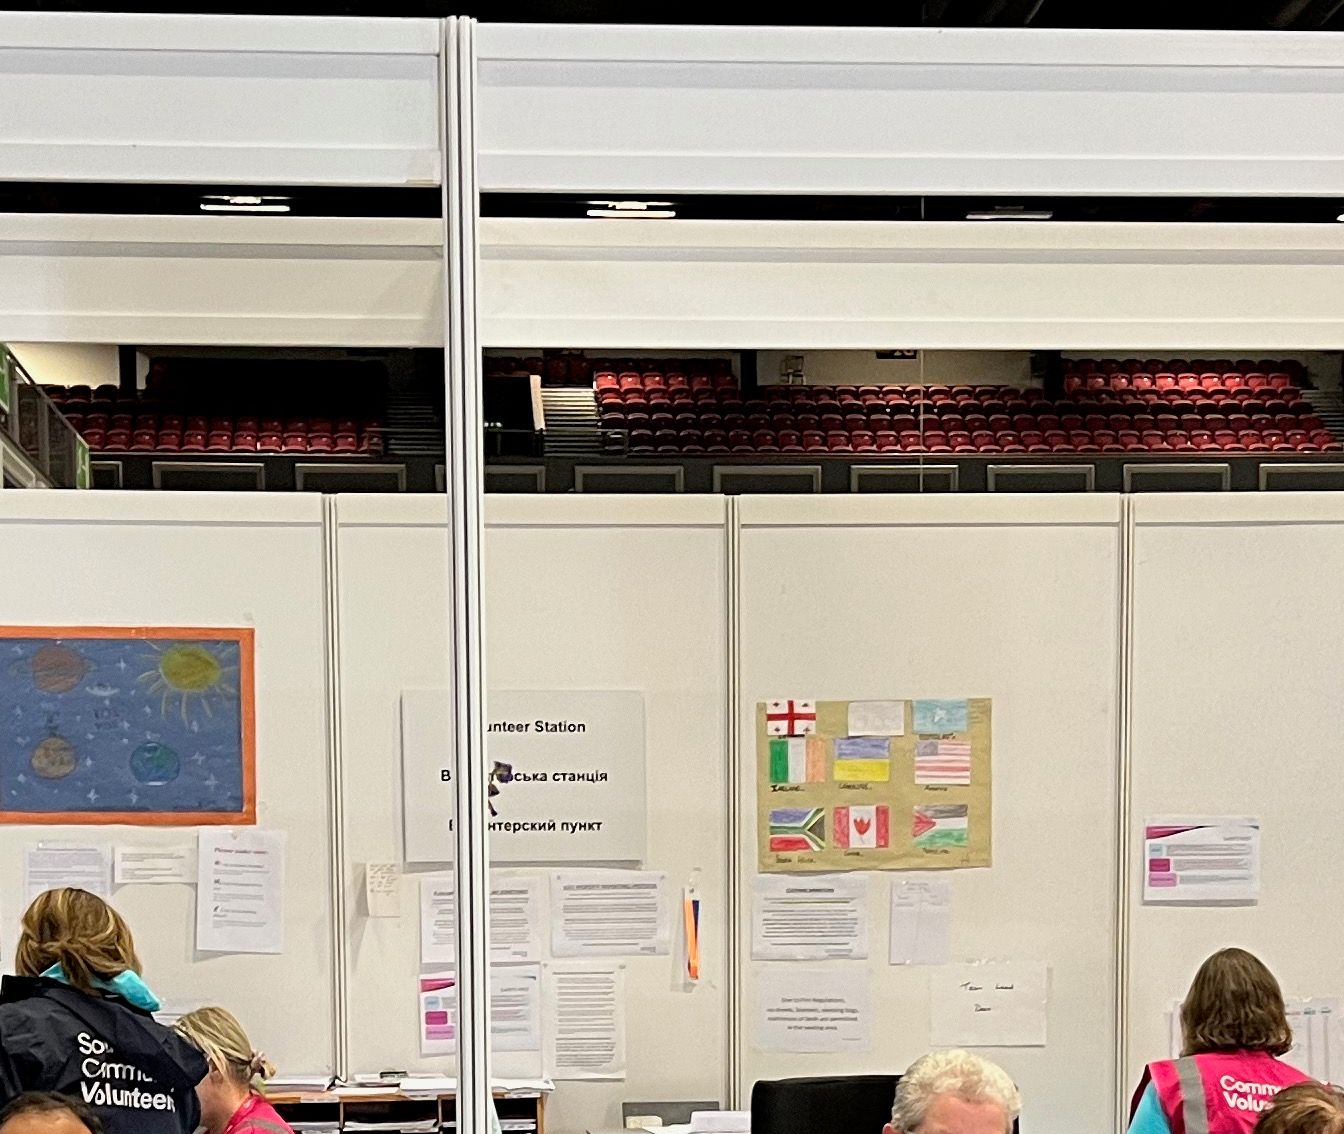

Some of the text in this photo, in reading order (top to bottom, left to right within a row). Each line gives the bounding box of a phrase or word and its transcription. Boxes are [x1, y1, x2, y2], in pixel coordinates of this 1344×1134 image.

[487, 720, 587, 733] nteer Station
[552, 769, 608, 783] станція
[561, 821, 603, 833] пункт
